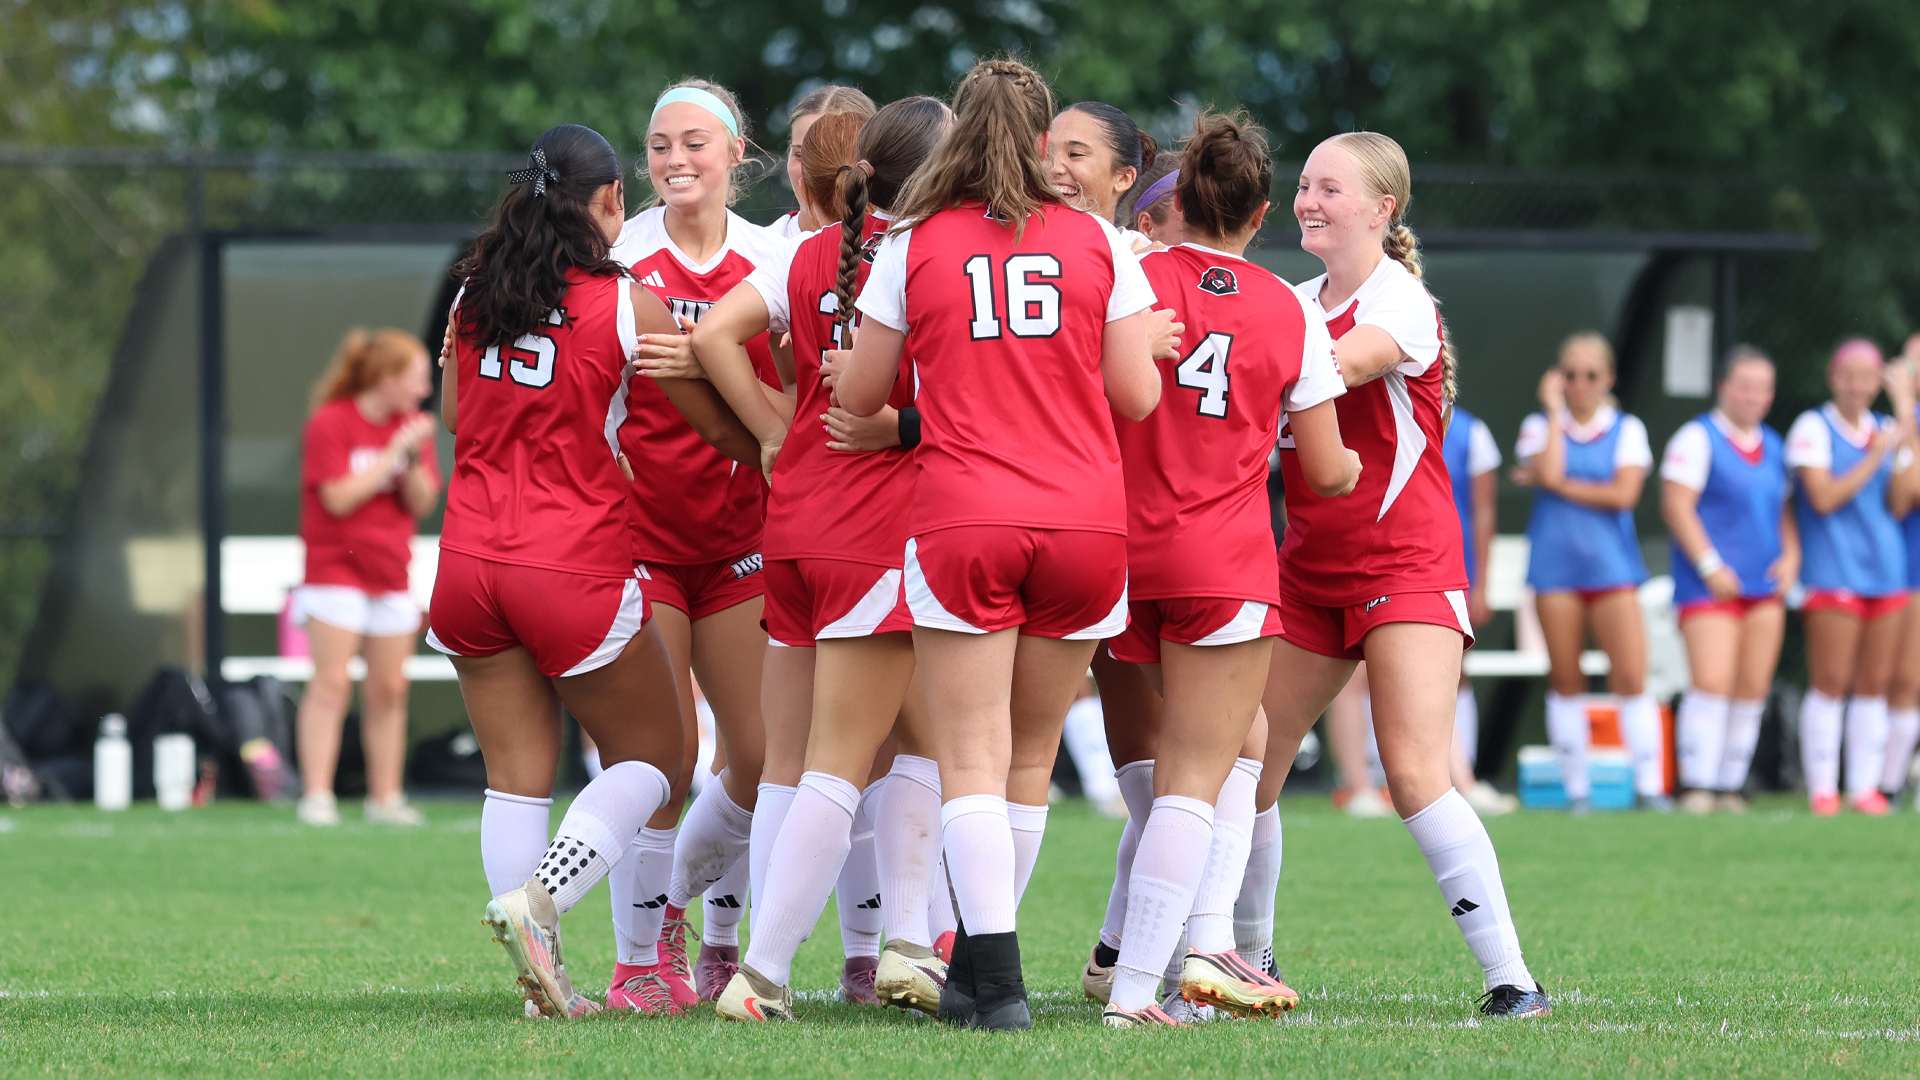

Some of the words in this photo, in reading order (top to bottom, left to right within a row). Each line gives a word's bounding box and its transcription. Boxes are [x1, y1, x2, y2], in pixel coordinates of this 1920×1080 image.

[963, 253, 1063, 342] 16
[1175, 331, 1235, 420] 4
[730, 551, 764, 580] IUP
